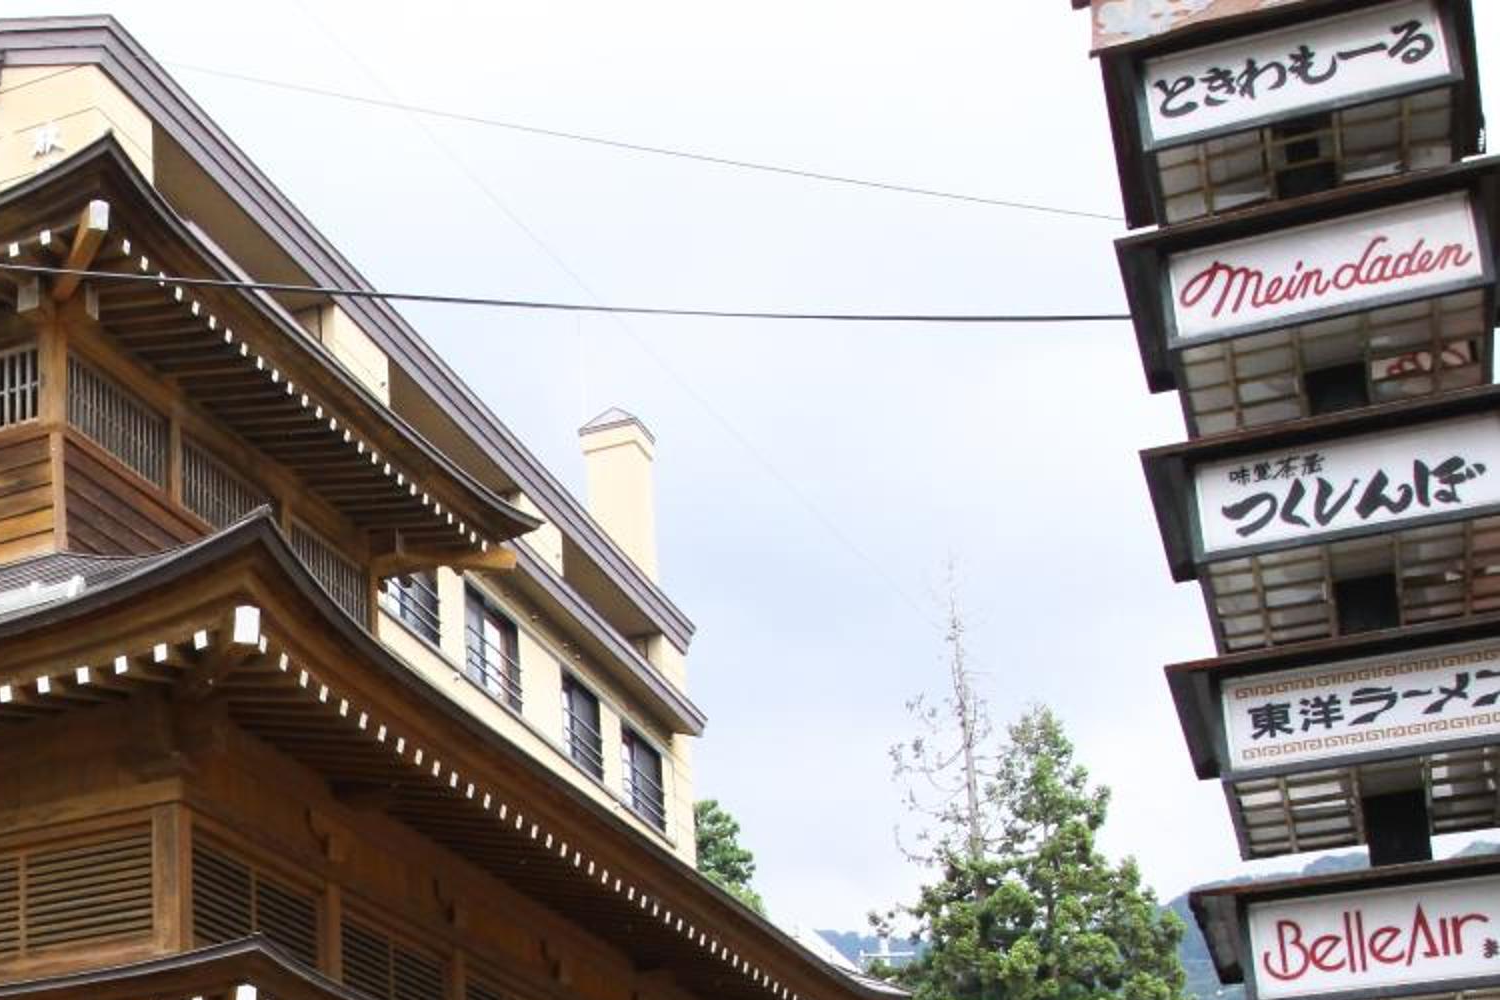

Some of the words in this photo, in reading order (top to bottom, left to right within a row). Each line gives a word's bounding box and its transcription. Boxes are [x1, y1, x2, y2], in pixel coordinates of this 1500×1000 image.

[1153, 19, 1435, 118] ときわもーる
[1221, 456, 1487, 537] つくしんぼ
